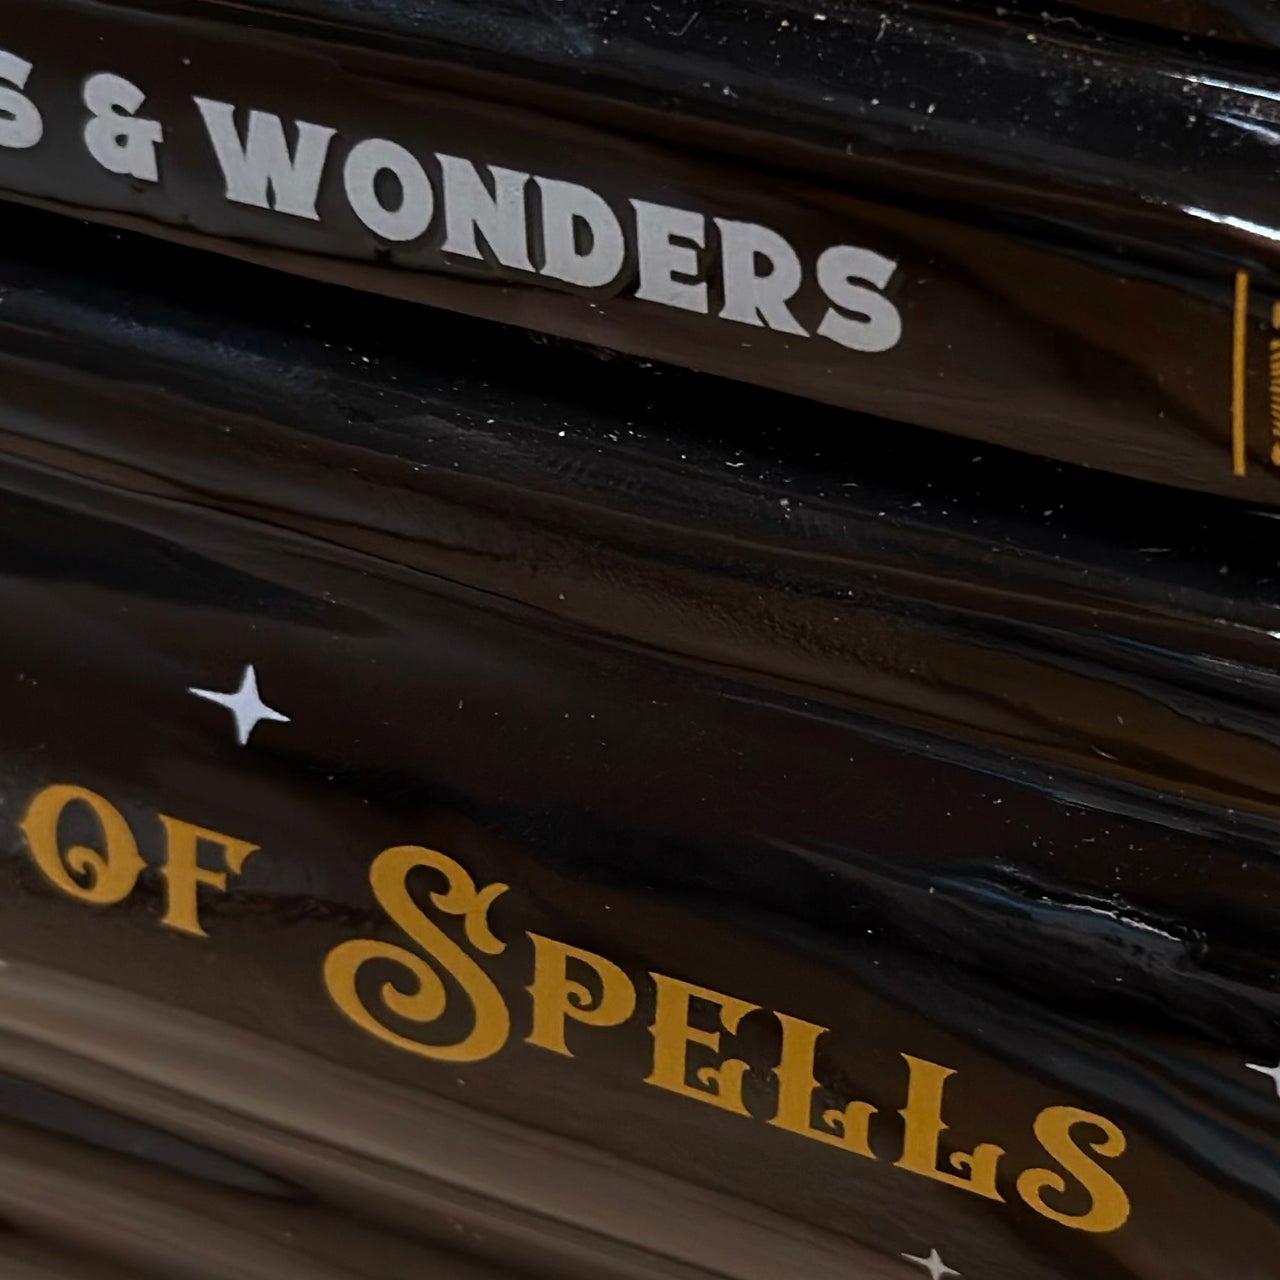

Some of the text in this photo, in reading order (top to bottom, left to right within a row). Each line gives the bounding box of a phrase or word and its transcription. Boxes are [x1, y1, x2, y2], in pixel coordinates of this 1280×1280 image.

[82, 72, 163, 182] &
[193, 95, 903, 354] WONDERS
[18, 781, 263, 937] OF
[323, 843, 1133, 1233] SPELLS
